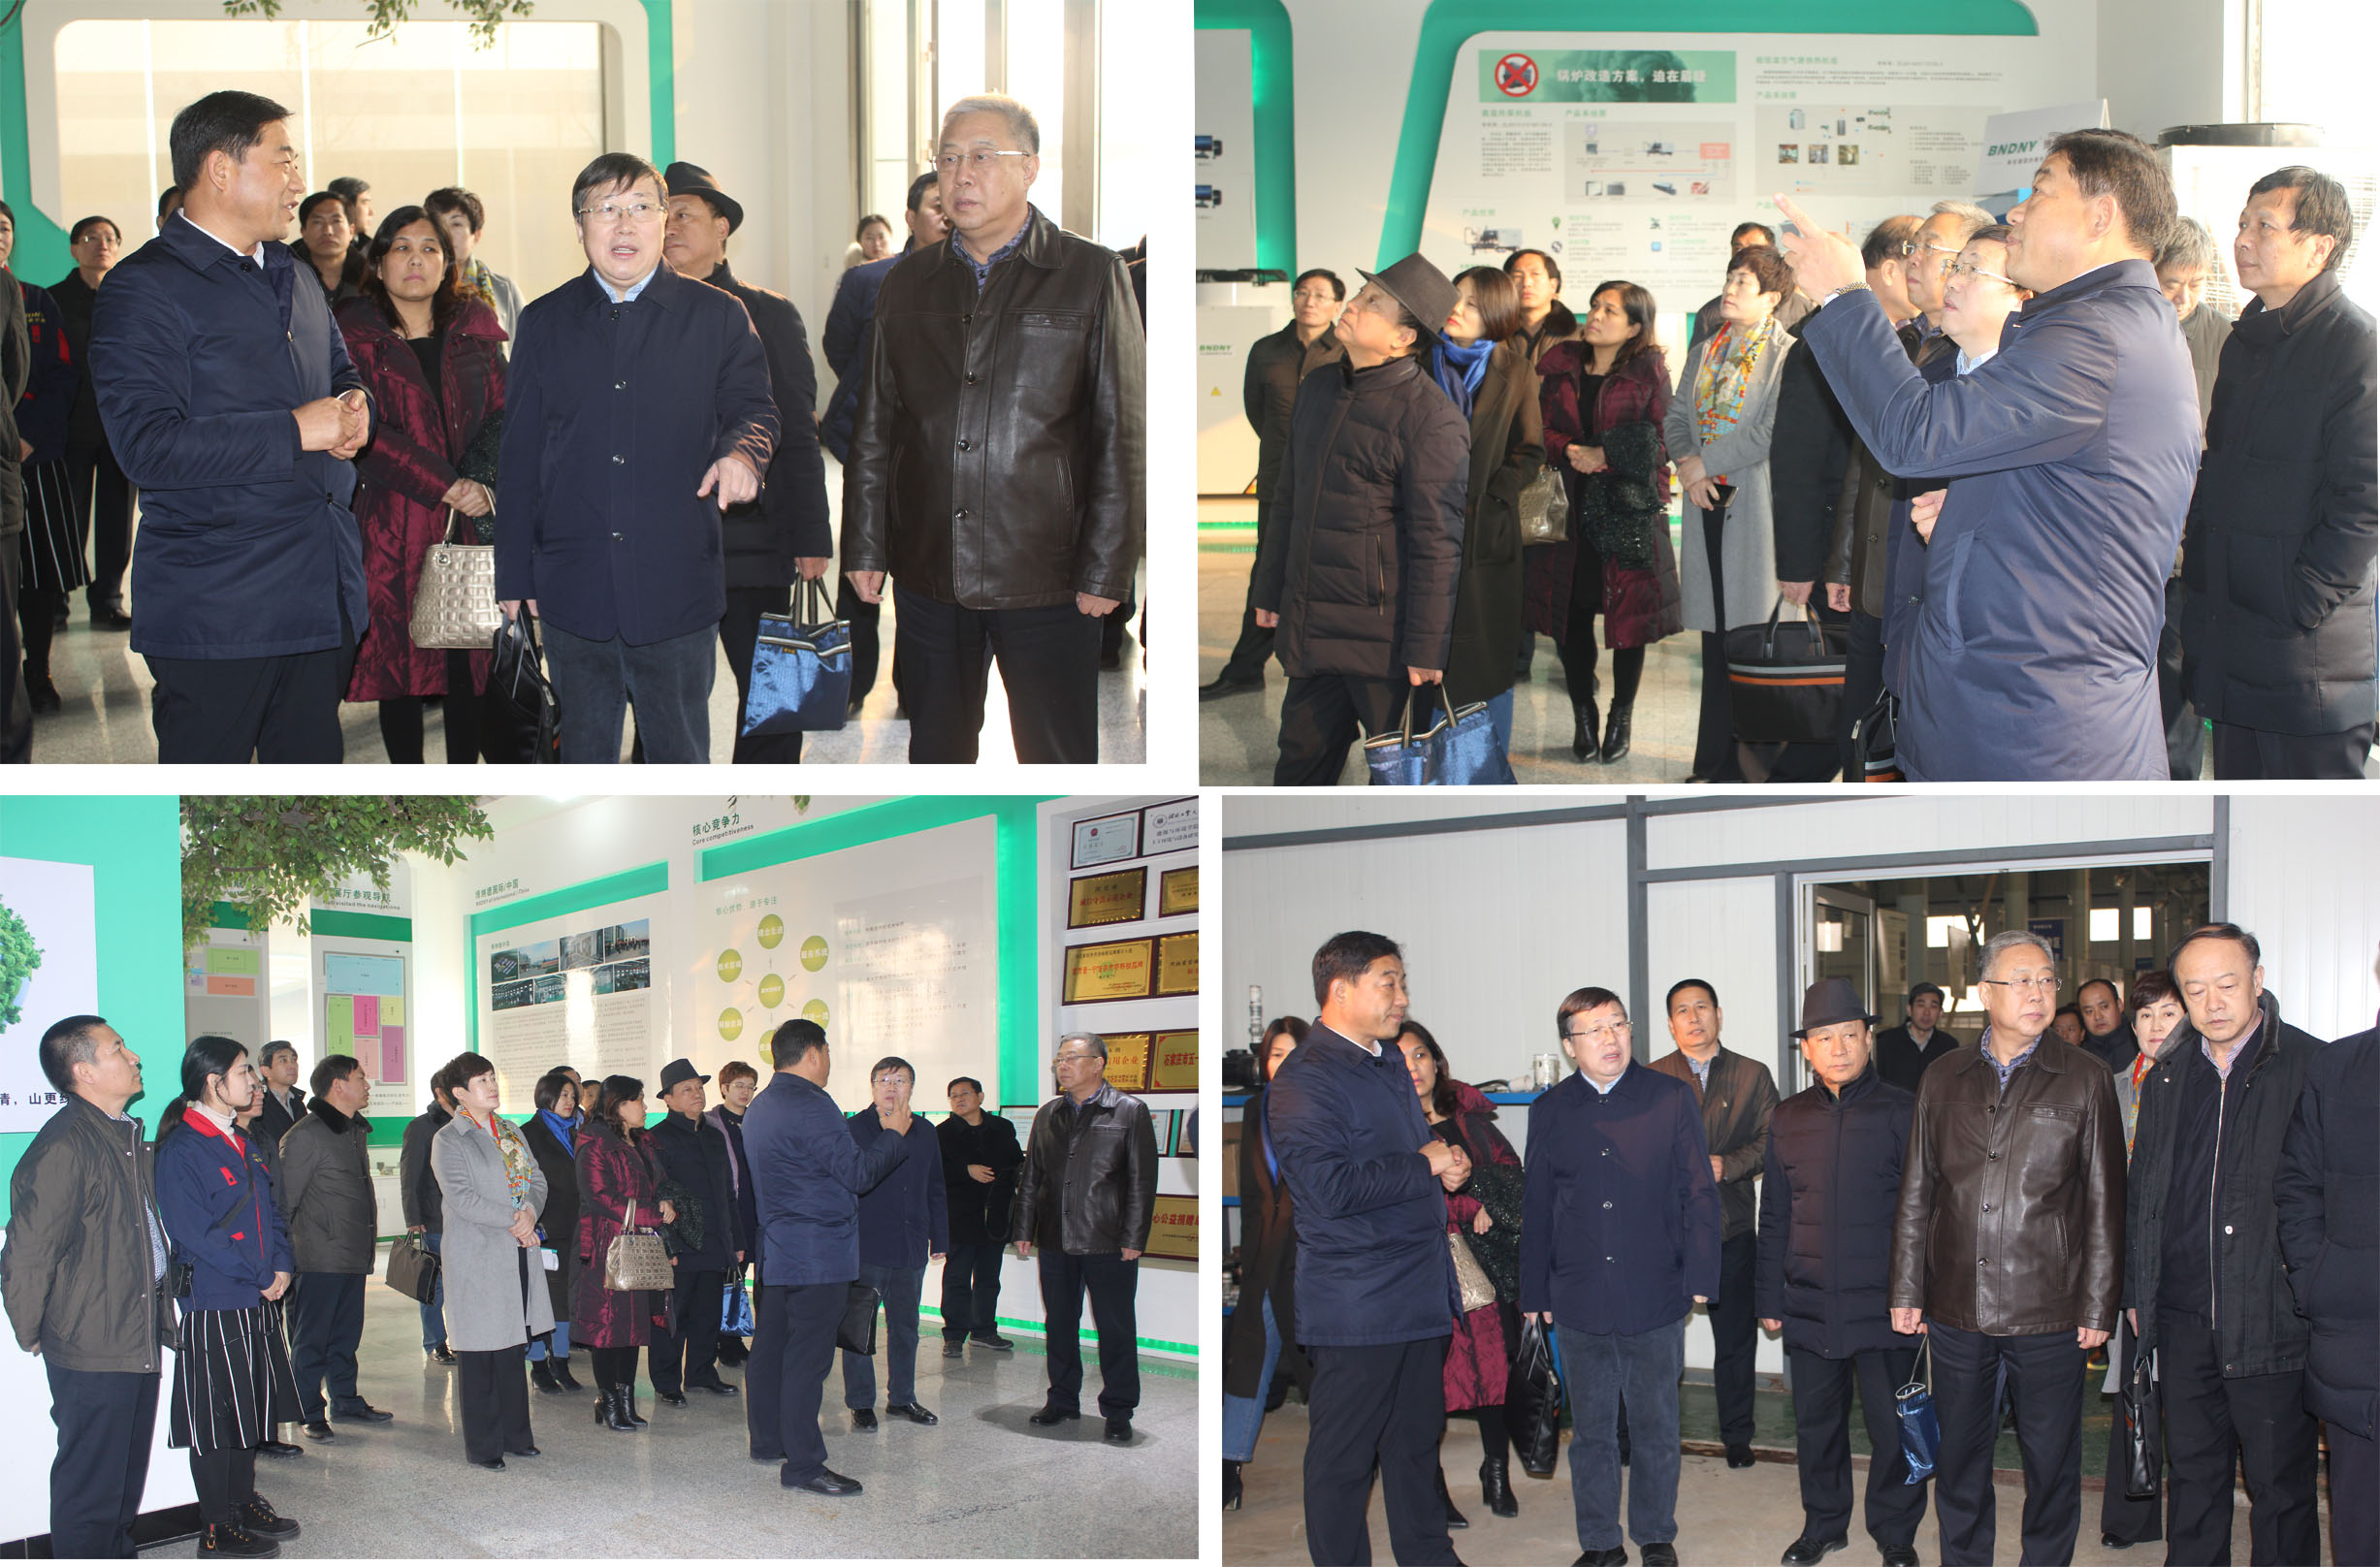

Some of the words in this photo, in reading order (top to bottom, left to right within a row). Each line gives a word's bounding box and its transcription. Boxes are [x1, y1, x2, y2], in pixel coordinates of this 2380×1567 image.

[1557, 69, 1707, 83] 锅炉改造方案，迫在眉睫
[1988, 140, 2038, 156] BNDNY
[692, 813, 740, 836] 核心竞争力
[706, 824, 754, 842] competitiveness
[1164, 1053, 1199, 1067] 石家庄市五一
